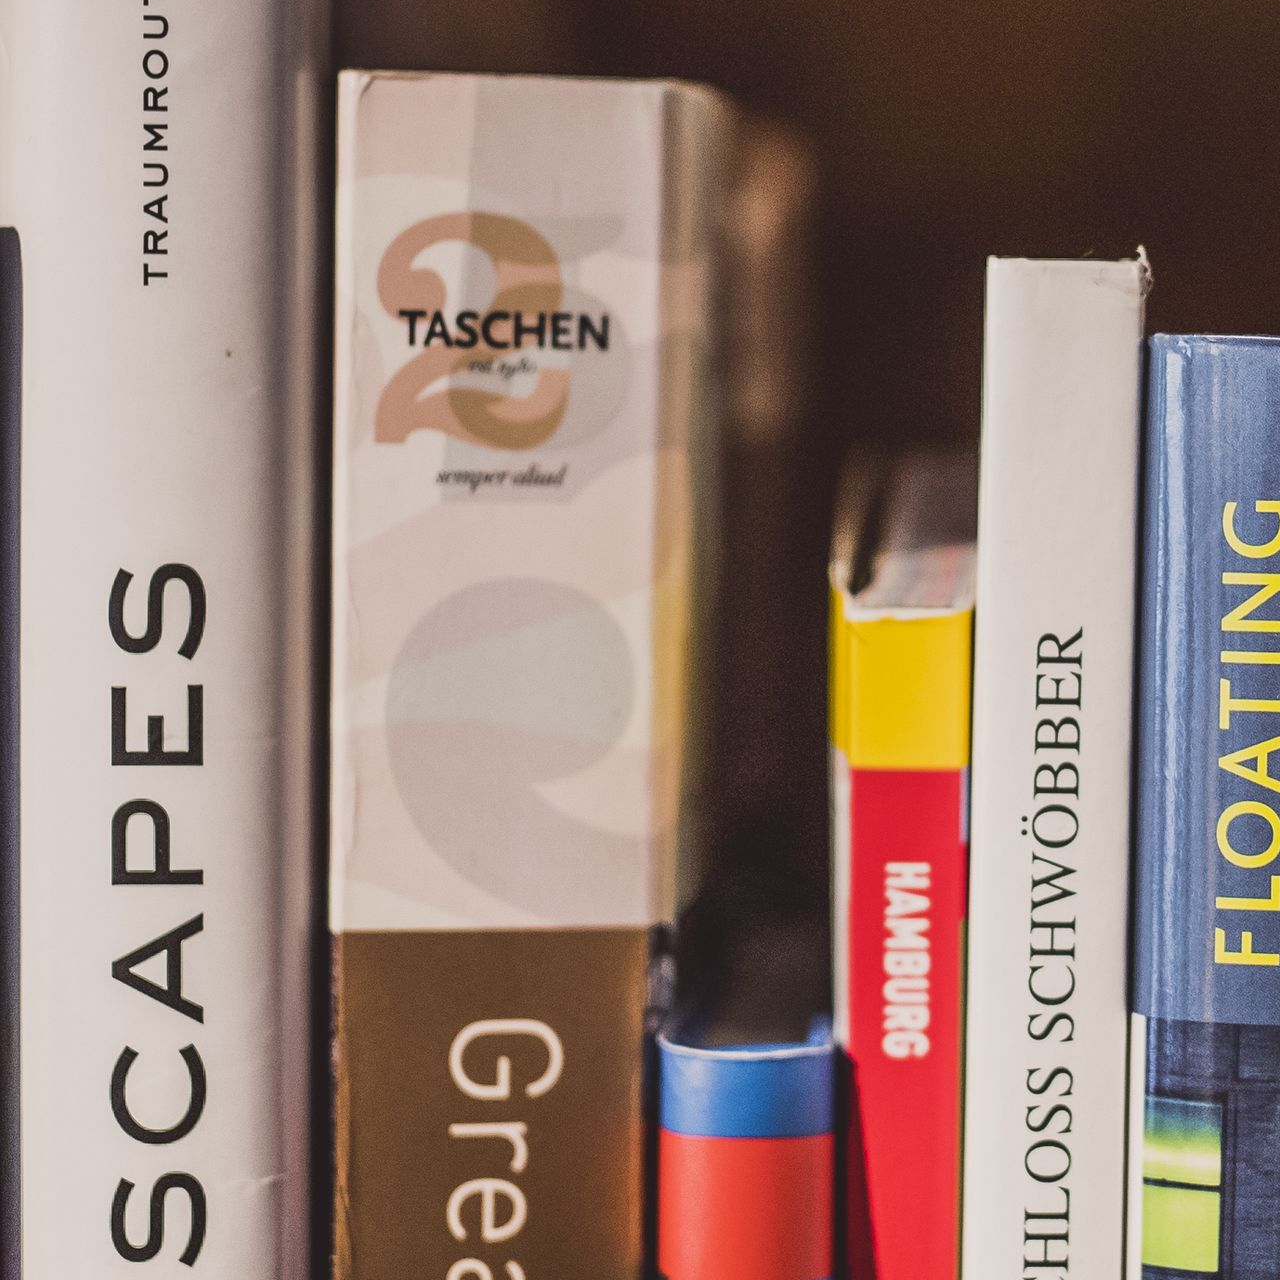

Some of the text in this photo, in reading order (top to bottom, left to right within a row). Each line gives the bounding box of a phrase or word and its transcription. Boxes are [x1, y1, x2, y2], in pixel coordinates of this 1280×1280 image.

[397, 308, 610, 351] TASCHEN
[1020, 625, 1084, 1043] SCHWÖBBER
[882, 862, 931, 1059] HAMBURG
